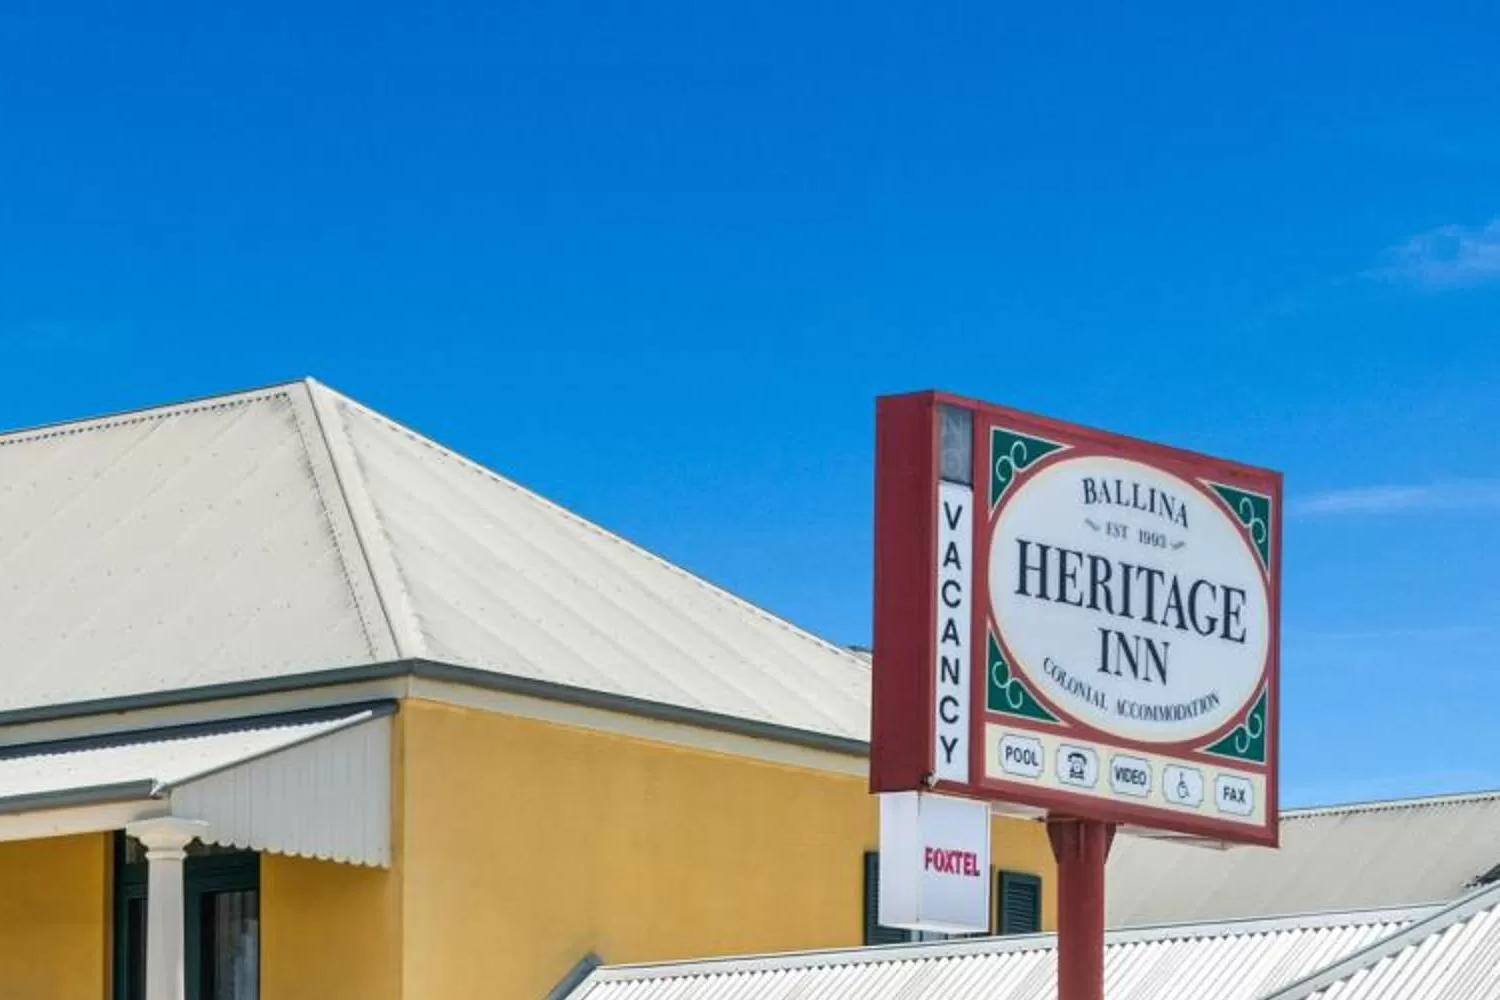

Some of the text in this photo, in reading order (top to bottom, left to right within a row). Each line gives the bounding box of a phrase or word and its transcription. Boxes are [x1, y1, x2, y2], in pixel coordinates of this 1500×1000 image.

[1081, 477, 1188, 529] BALLINA
[1105, 521, 1129, 540] EST
[1014, 538, 1248, 644] HERITAGE
[939, 501, 963, 765] VACANCY
[1097, 627, 1170, 686] INN
[1043, 656, 1221, 721] COLONIAL ACCOMMODATION
[1004, 745, 1039, 768] POOL
[1114, 765, 1147, 787] VIDEO
[1223, 785, 1247, 804] FAX
[924, 846, 981, 877] FOXTEL
